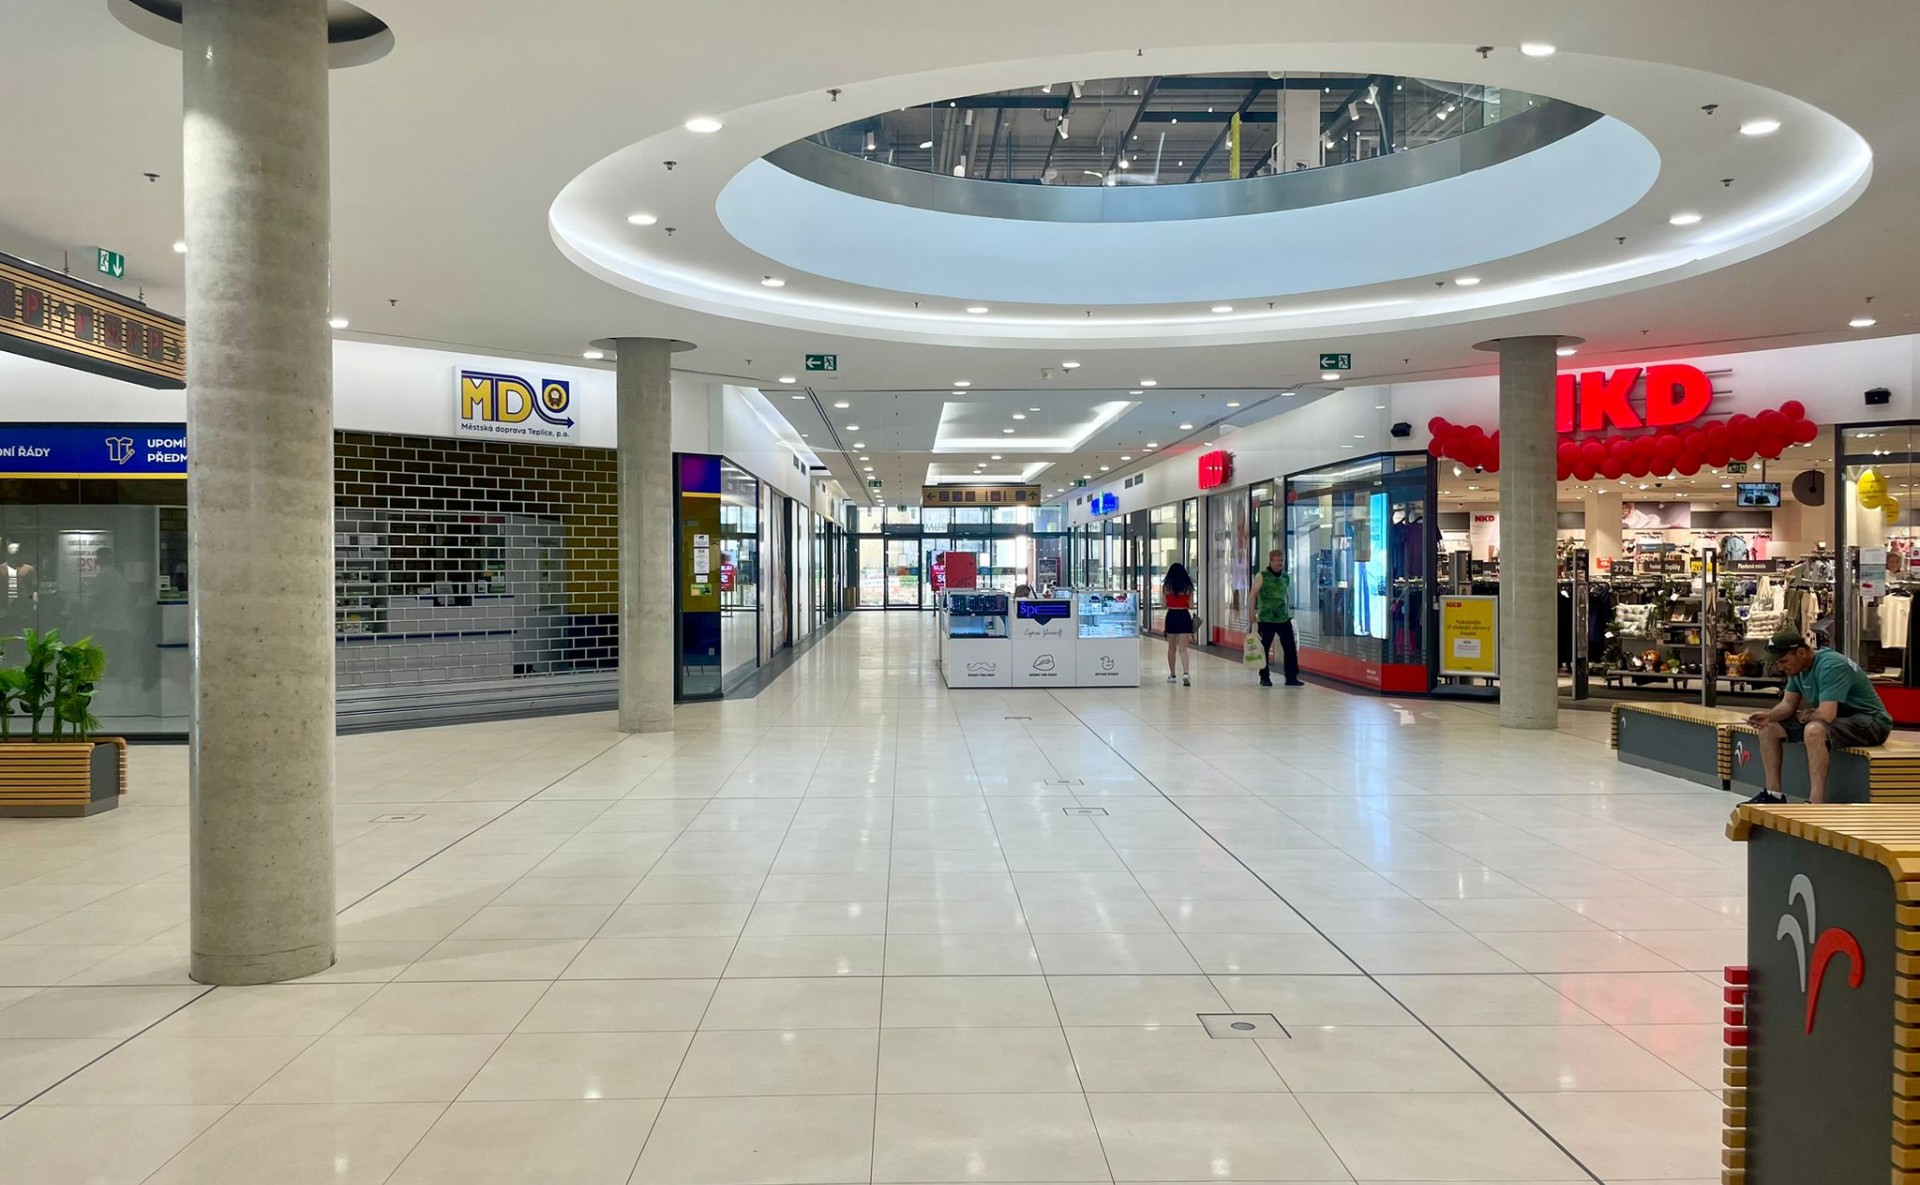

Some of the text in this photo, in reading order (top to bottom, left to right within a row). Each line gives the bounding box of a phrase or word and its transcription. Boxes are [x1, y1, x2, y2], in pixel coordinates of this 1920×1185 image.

[461, 423, 493, 432] Městská
[495, 424, 526, 435] doprava
[528, 428, 555, 438] Teplice,
[147, 436, 187, 448] UPOMÍ
[18, 446, 51, 457] ŘÁDY
[1474, 514, 1495, 522] NKD
